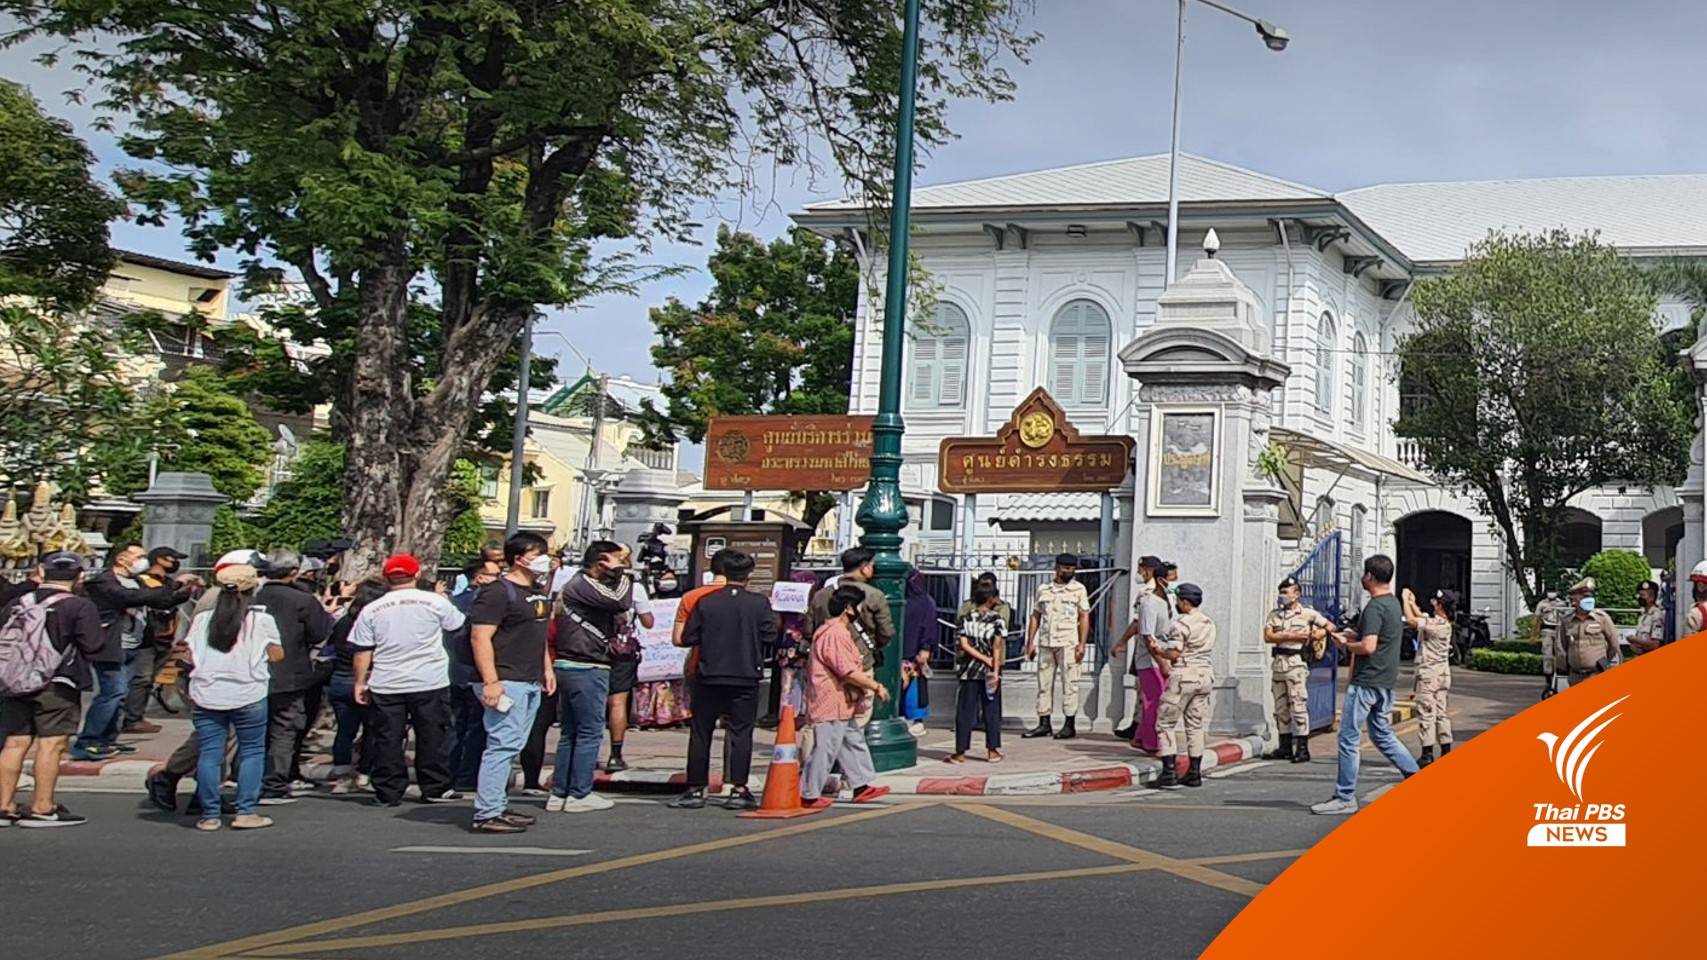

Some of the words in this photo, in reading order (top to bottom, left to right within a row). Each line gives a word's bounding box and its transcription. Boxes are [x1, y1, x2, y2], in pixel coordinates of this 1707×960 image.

[963, 447, 1111, 474] ศูนย์ดำรงธรรม
